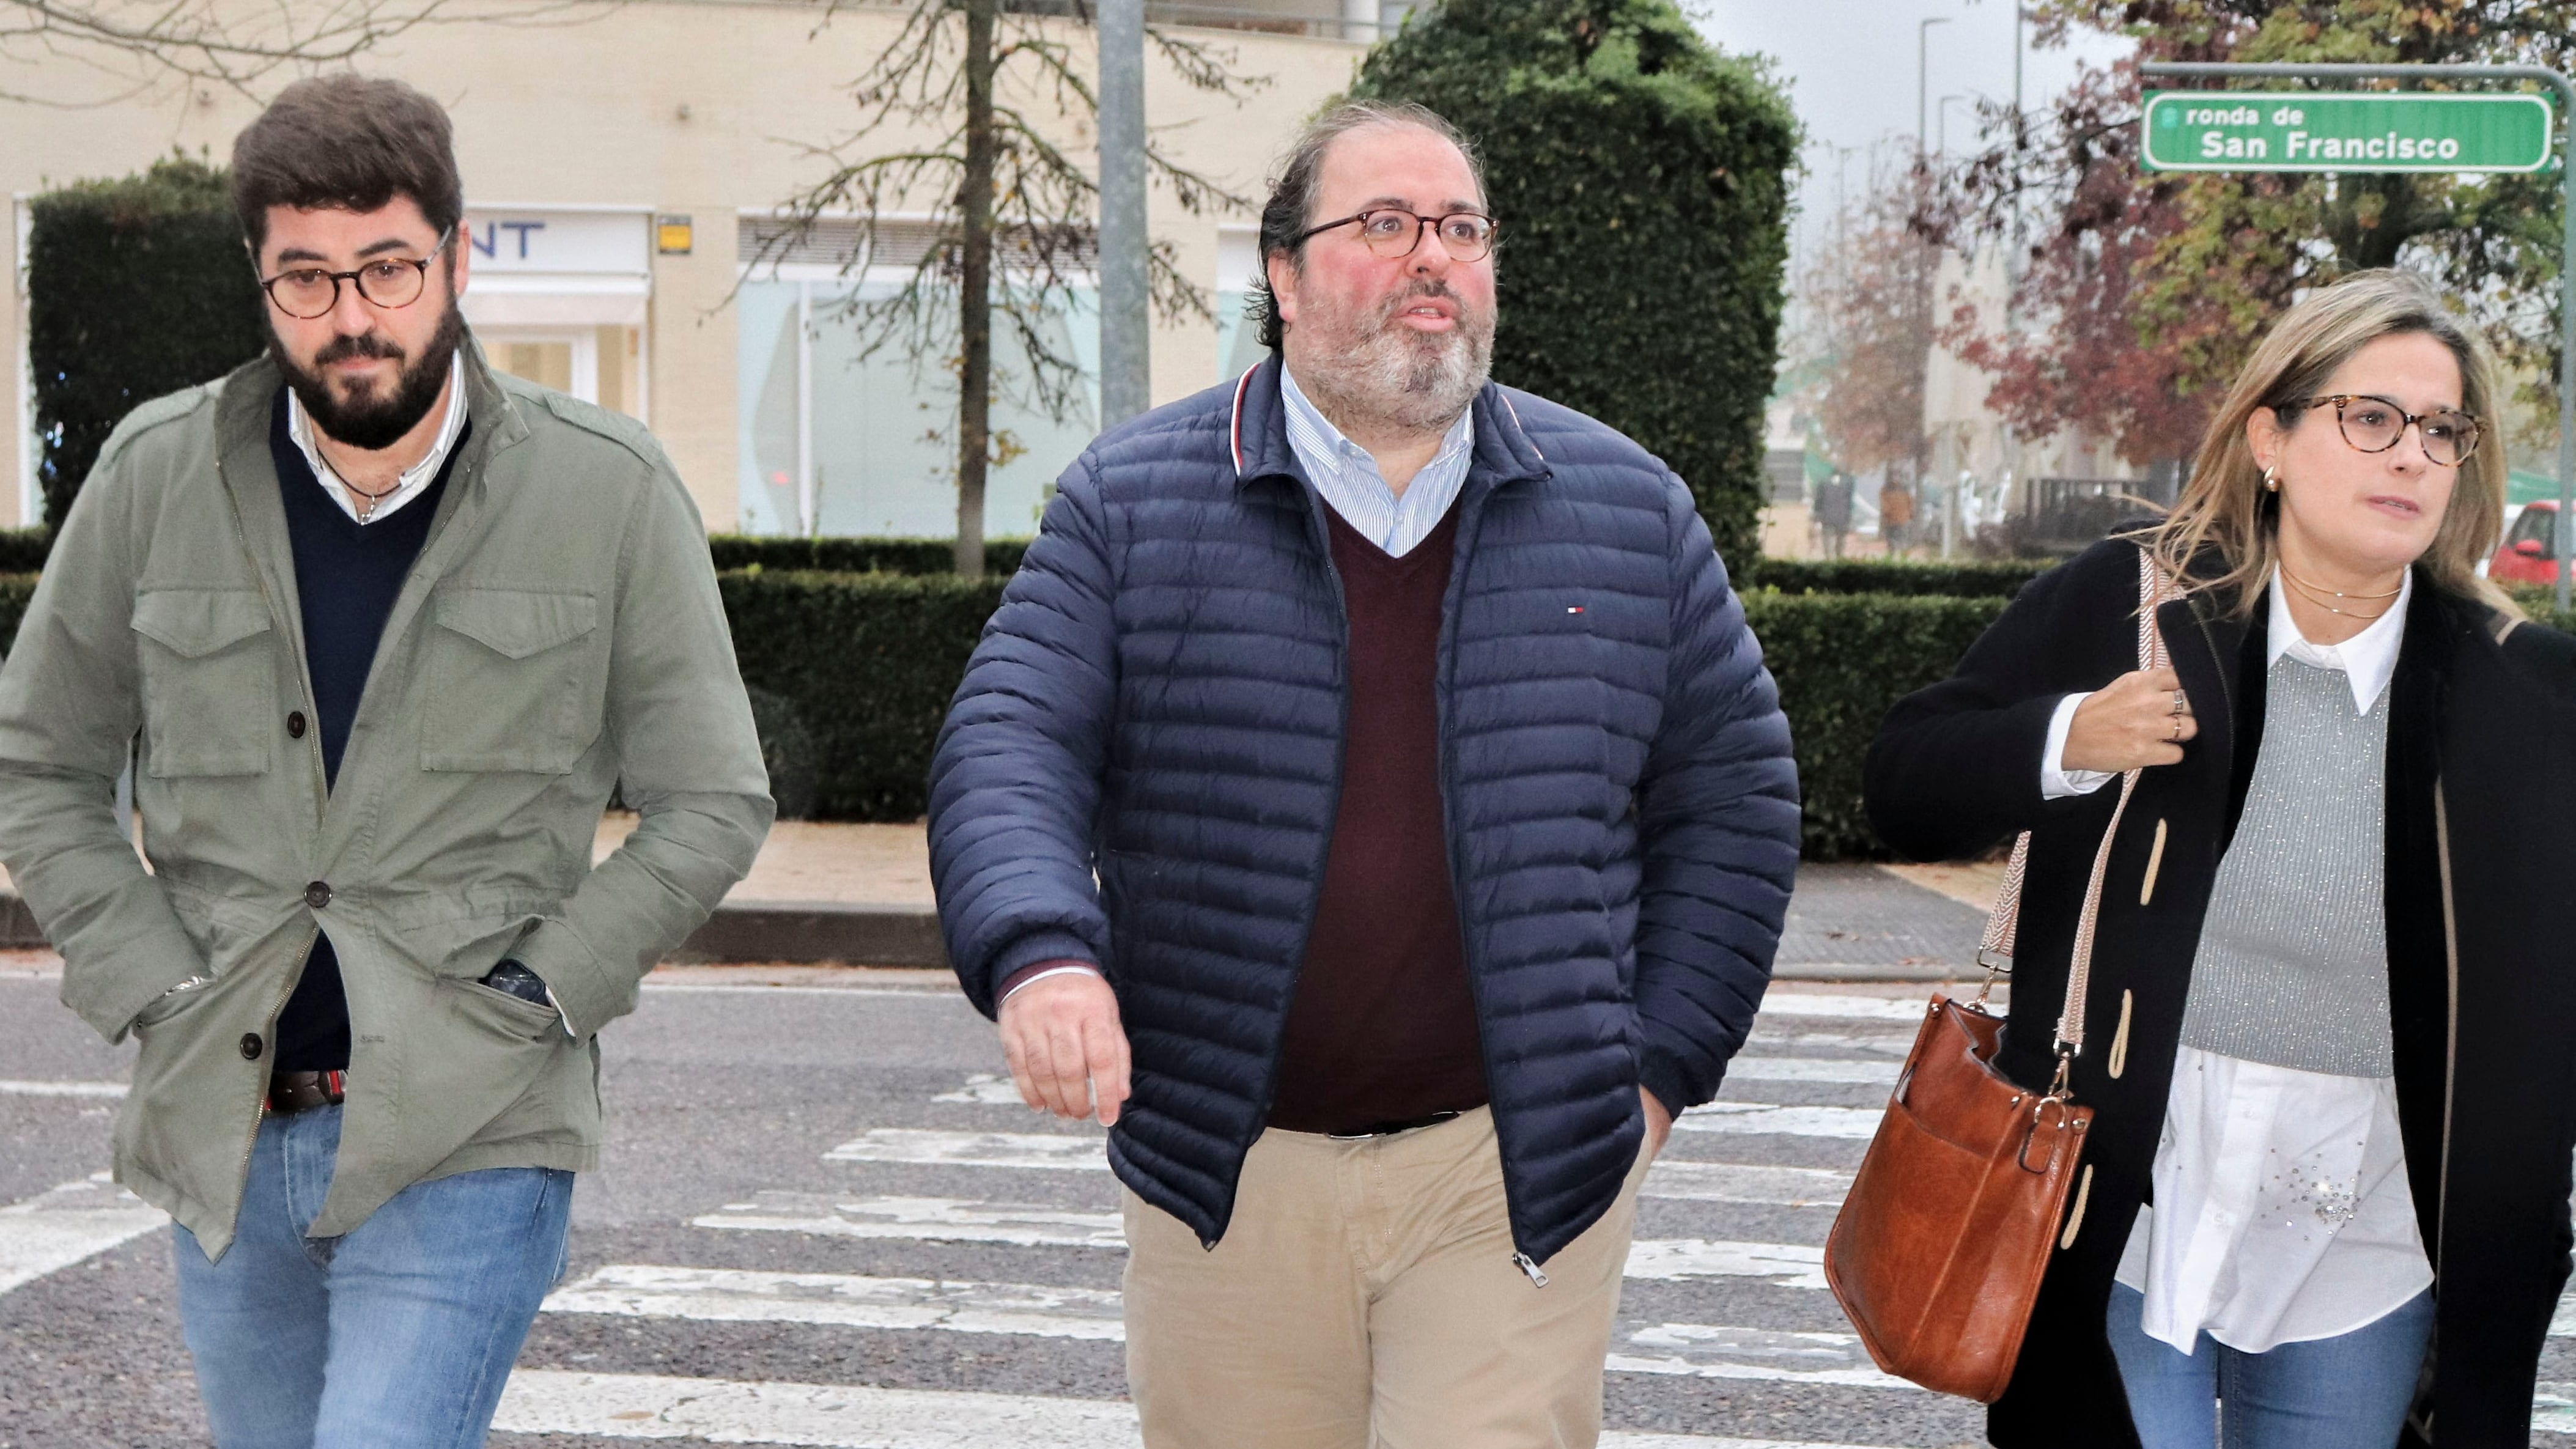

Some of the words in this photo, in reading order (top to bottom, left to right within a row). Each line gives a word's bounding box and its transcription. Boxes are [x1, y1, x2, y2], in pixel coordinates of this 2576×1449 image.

[2185, 106, 2260, 125] ronda
[2272, 106, 2304, 126] de
[2201, 130, 2267, 158] San
[2287, 131, 2459, 159] Francisco
